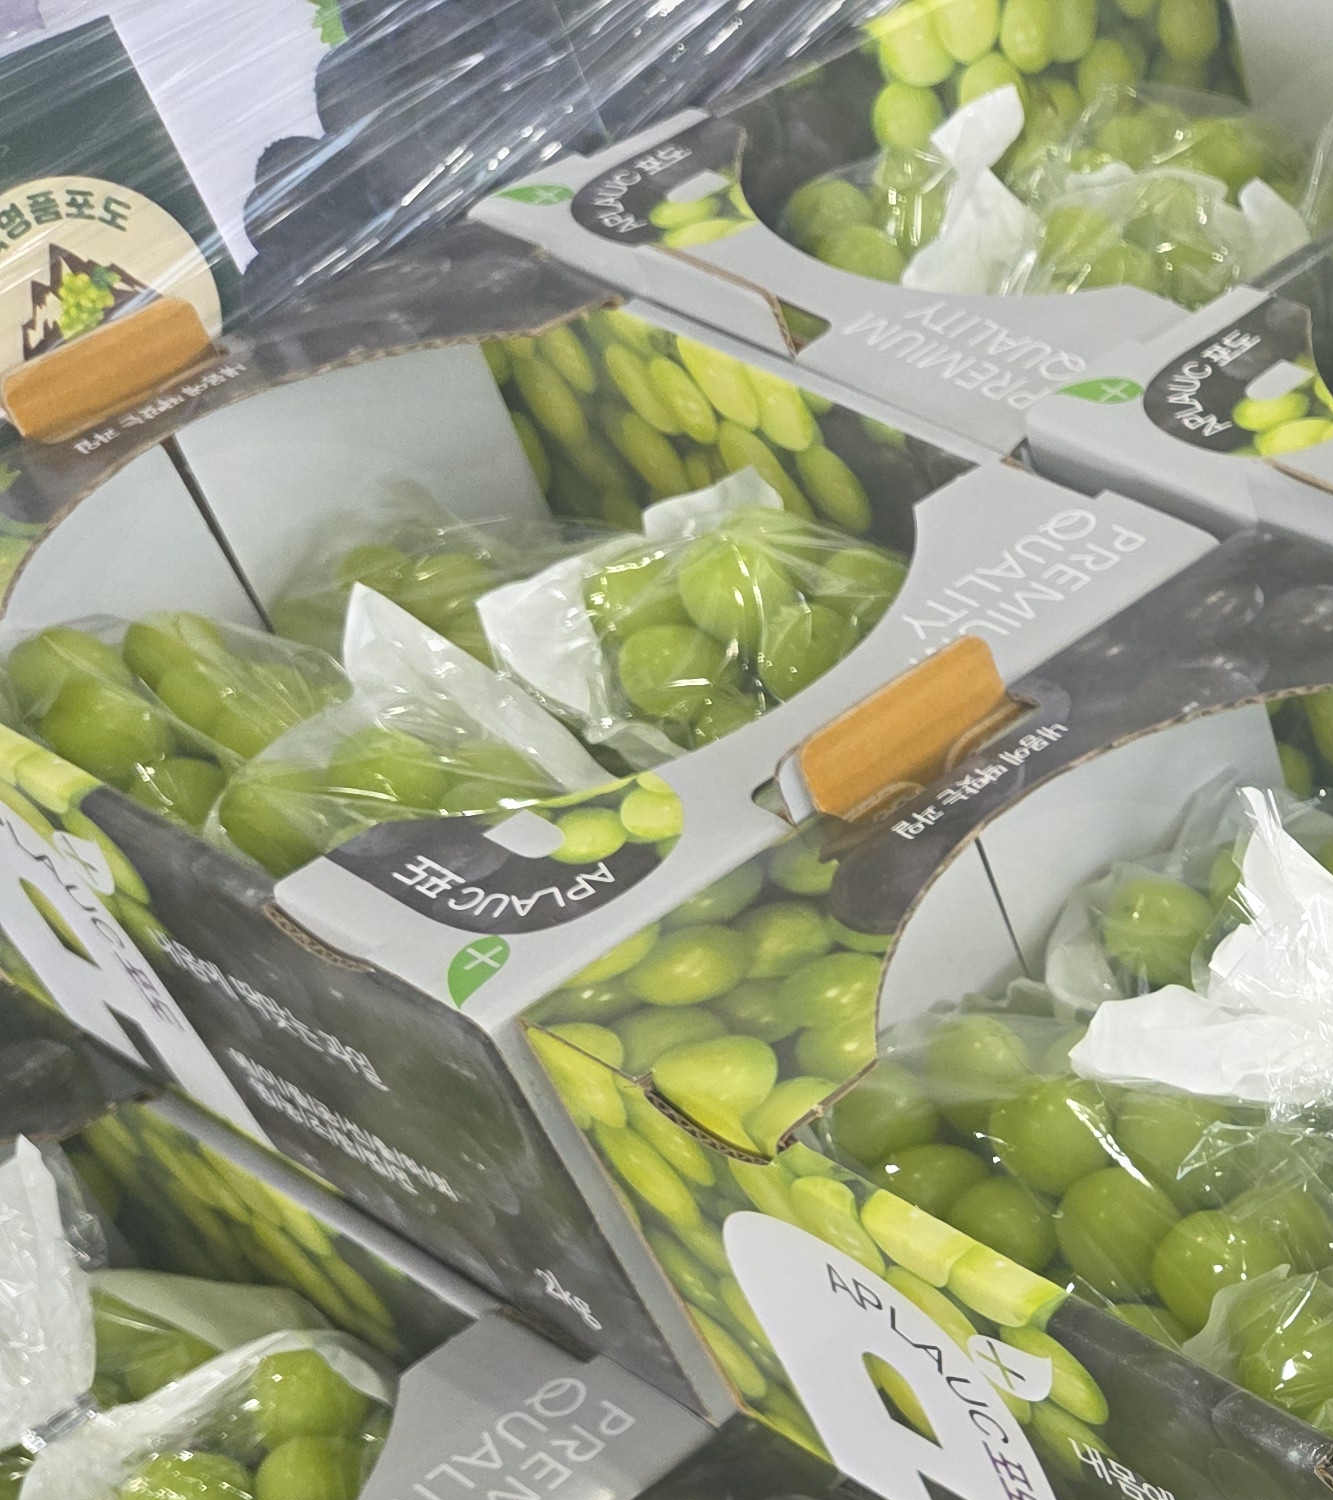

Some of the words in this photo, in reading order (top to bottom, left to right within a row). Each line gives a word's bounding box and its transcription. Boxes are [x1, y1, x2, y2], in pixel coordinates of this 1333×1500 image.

[842, 309, 1050, 412] PREMIUM
[904, 299, 1087, 381] QUALITY
[902, 508, 1097, 640] QUALITY
[907, 524, 1148, 665] PREMIU
[392, 855, 467, 899] 포도
[448, 862, 616, 919] APLAUC
[533, 1267, 603, 1331] 2kg
[826, 1262, 1009, 1444] APLAUC
